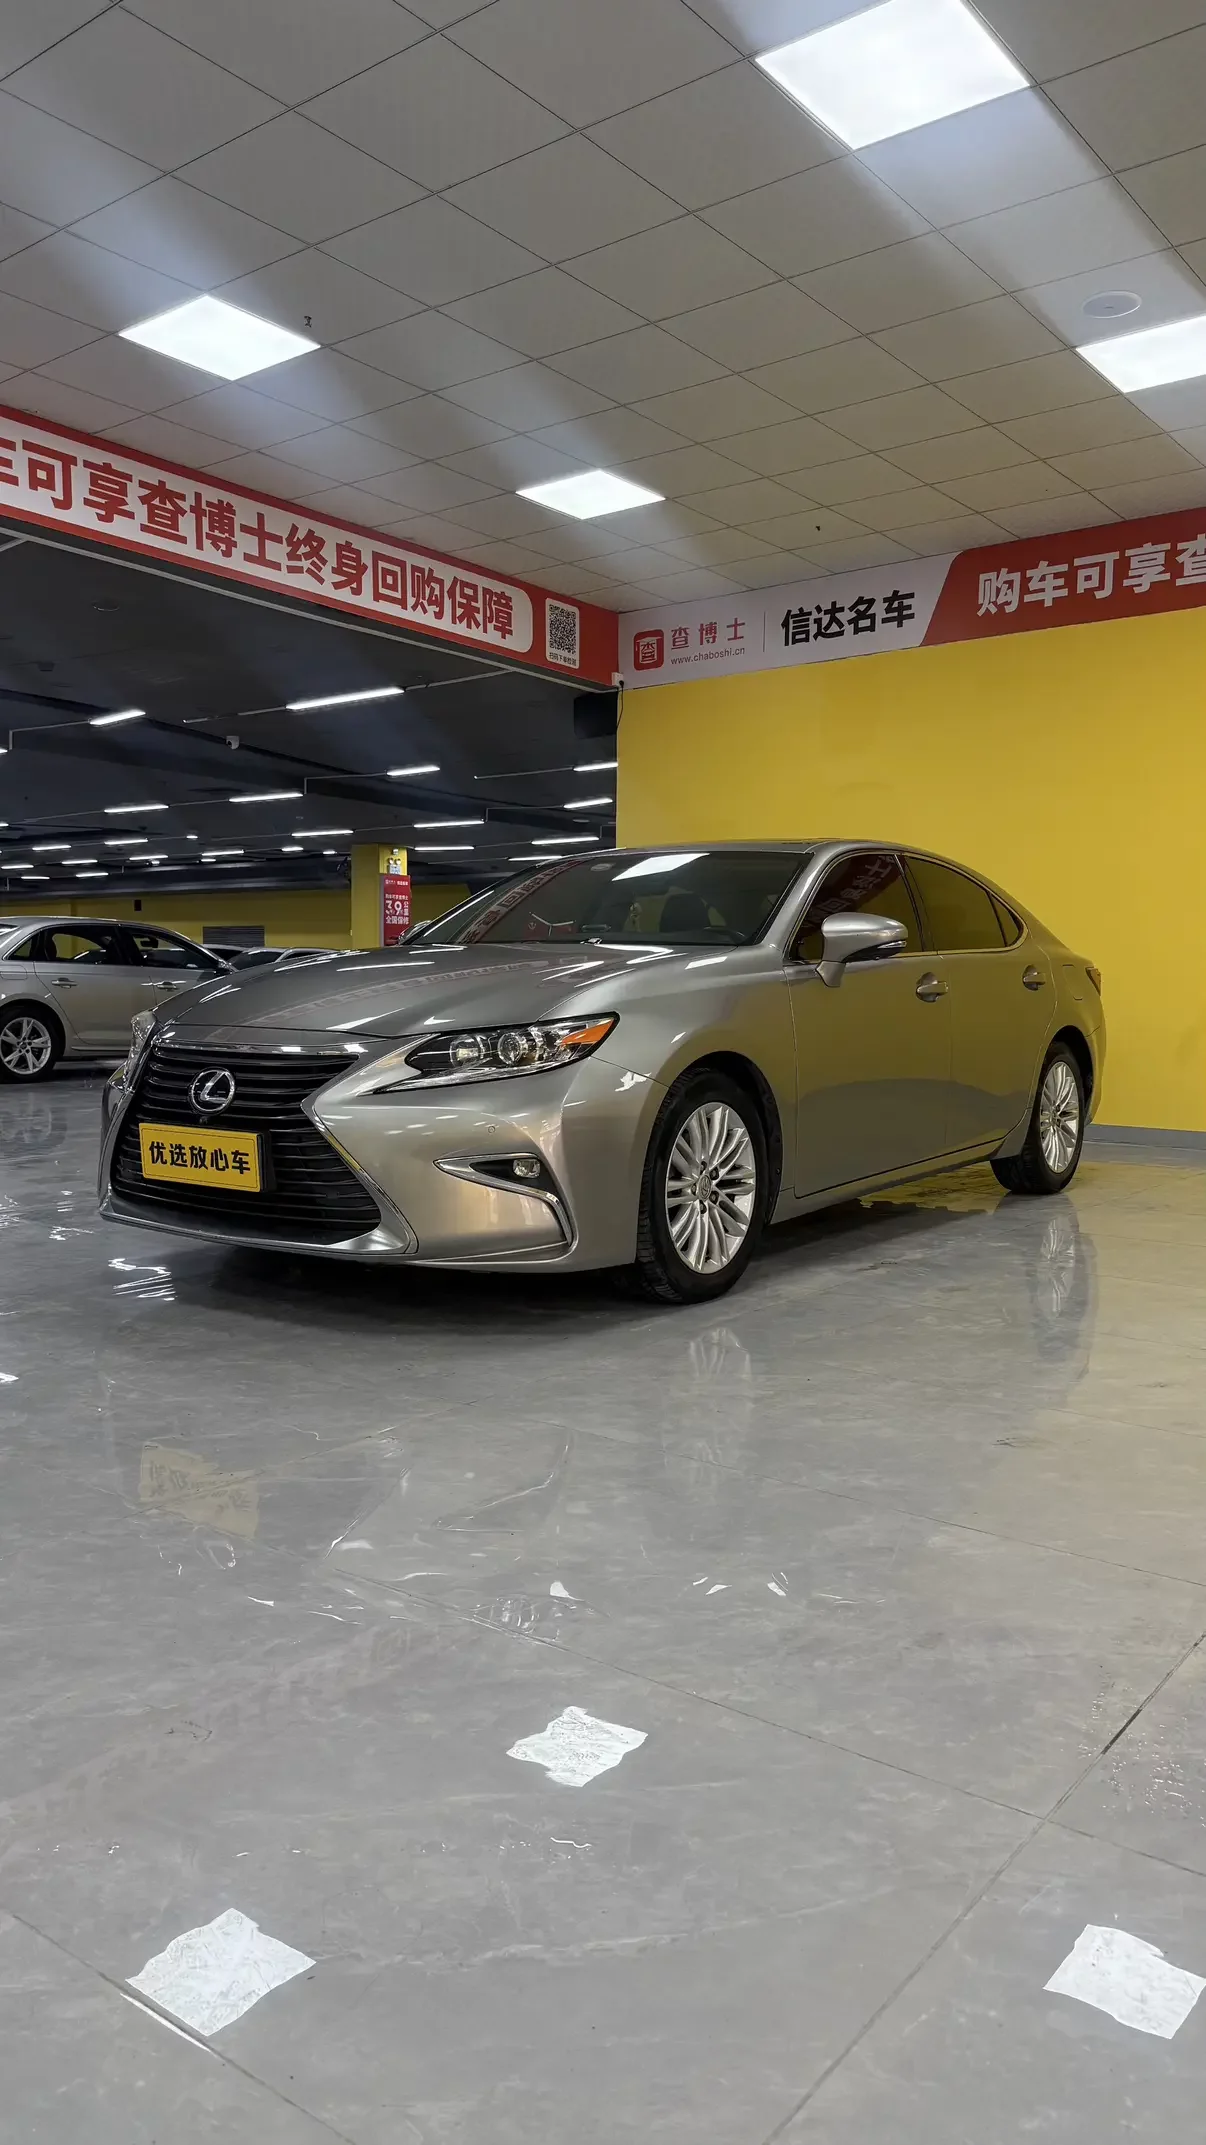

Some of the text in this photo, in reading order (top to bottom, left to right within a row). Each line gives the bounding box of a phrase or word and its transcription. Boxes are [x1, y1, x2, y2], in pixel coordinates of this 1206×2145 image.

[671, 617, 745, 650] 查博士
[781, 590, 916, 646] 信达名车
[671, 647, 745, 665] www.chaboshi.cn
[149, 1141, 250, 1174] 优选放心车
